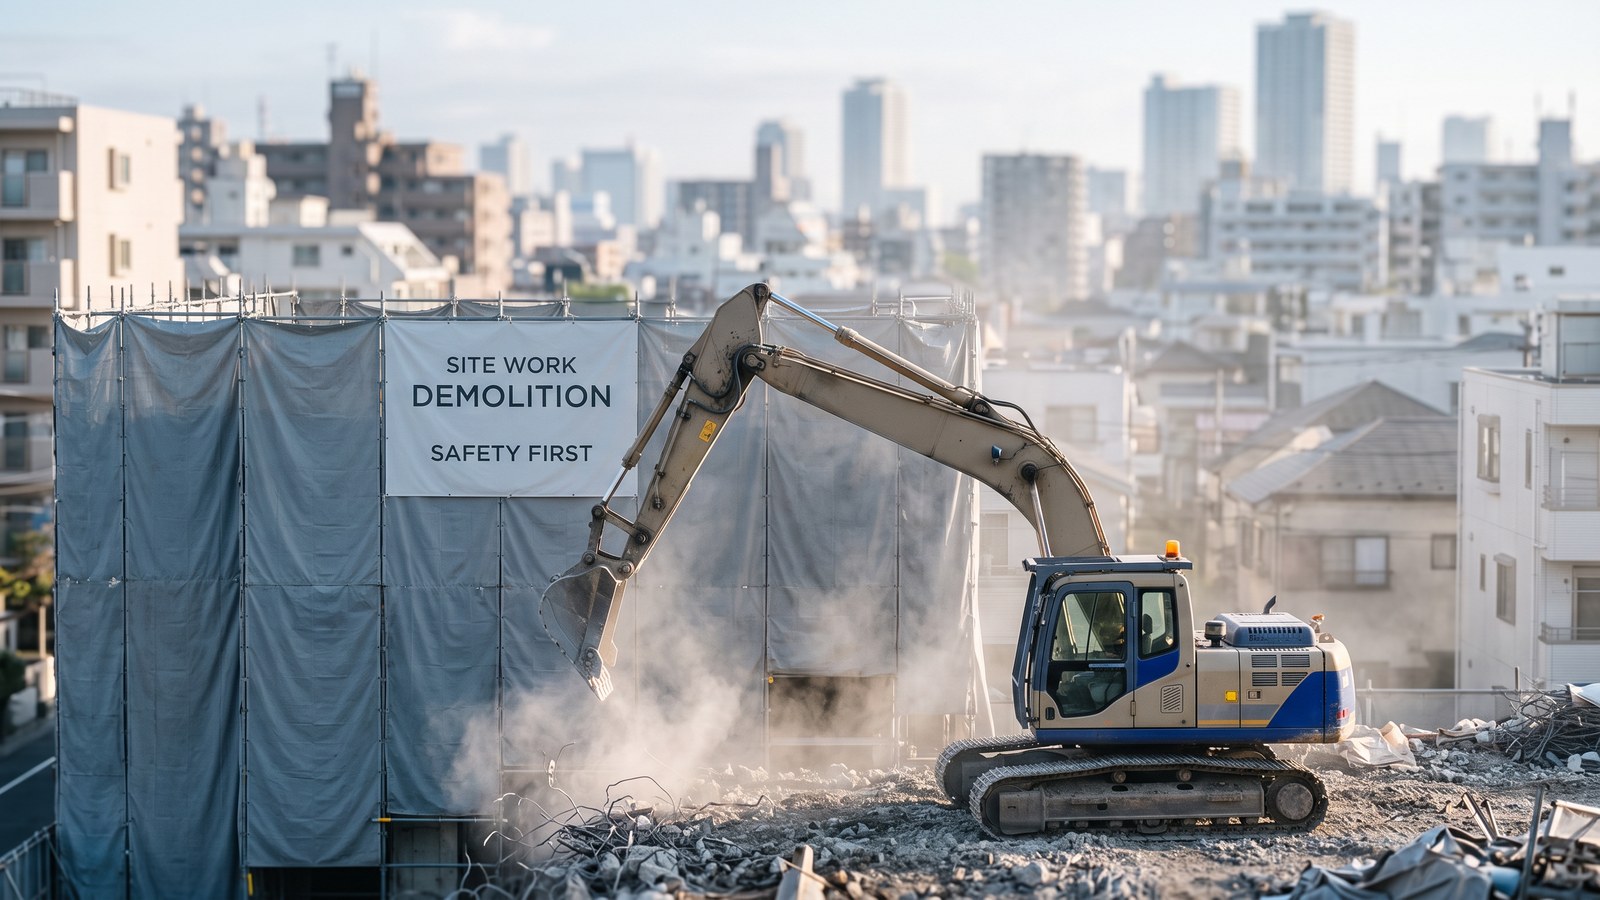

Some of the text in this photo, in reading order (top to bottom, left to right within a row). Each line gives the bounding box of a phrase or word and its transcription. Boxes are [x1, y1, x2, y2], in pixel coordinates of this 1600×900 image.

[447, 357, 576, 373] SITE WORK
[413, 385, 610, 407] DEMOLITION
[431, 445, 592, 461] SAFETY FIRST
